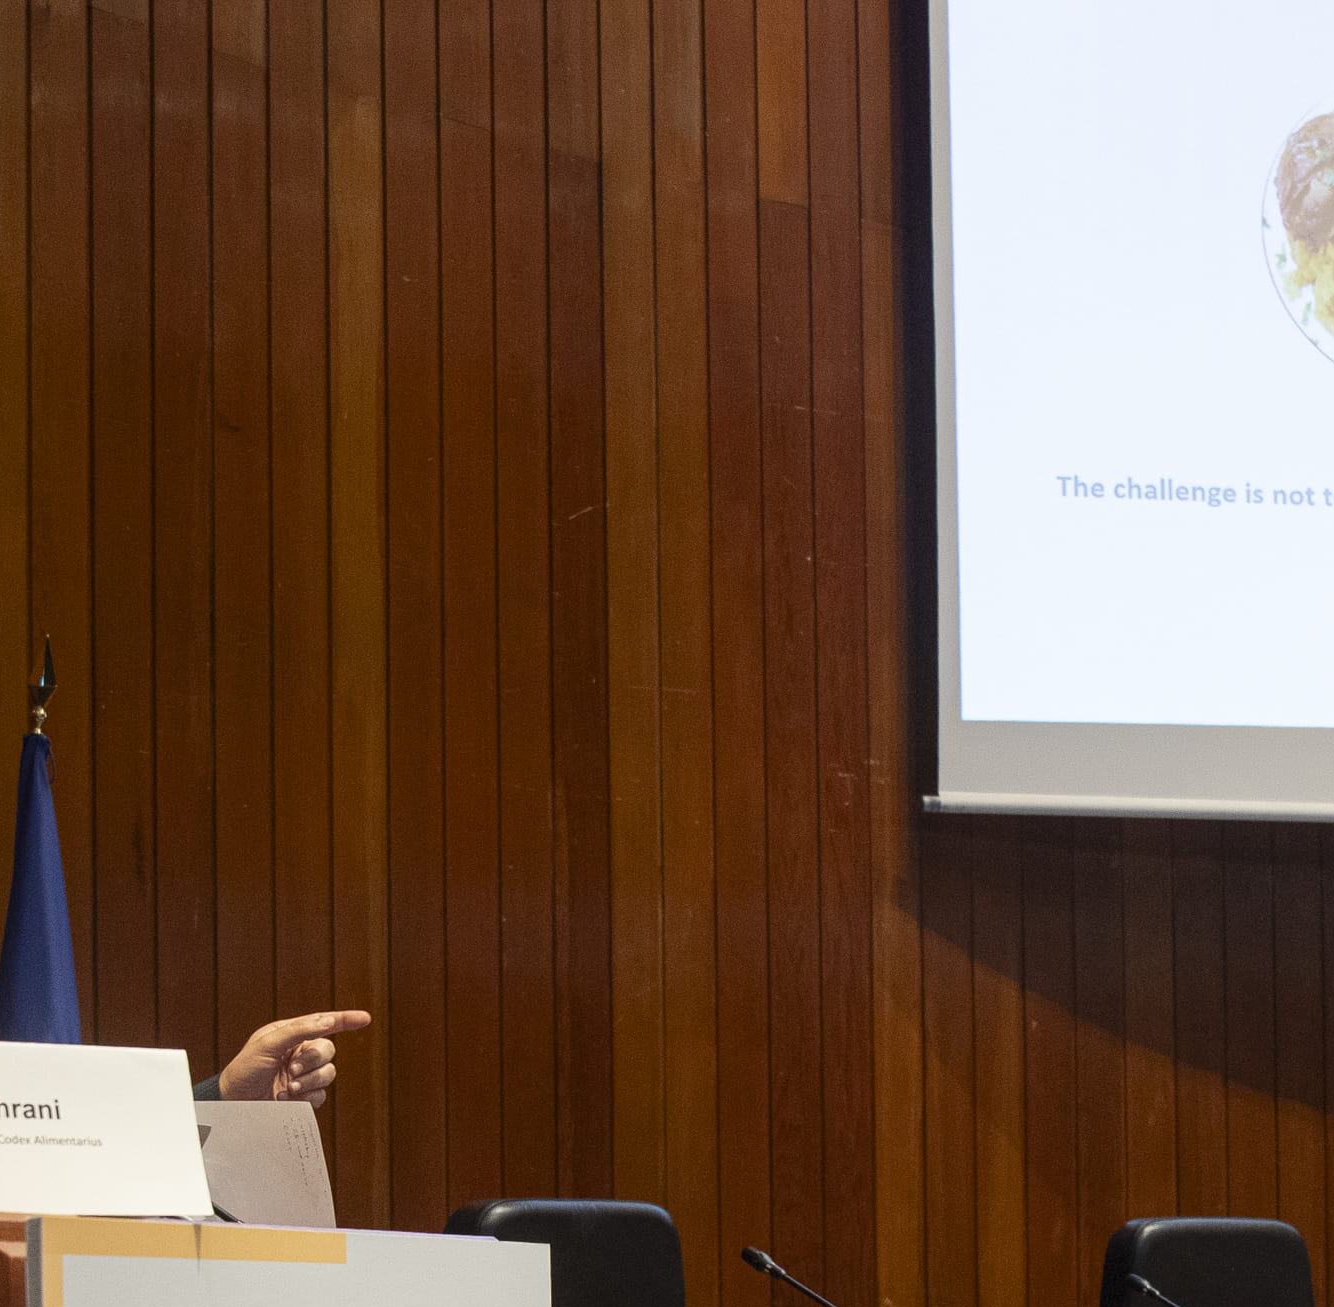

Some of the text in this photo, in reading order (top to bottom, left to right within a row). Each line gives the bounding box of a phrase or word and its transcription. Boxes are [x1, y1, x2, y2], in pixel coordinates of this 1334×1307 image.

[1055, 474, 1106, 499] The
[1113, 476, 1237, 508] challenge
[1245, 481, 1264, 504] is
[1272, 487, 1316, 507] not
[34, 1136, 102, 1146] Alimentarius
